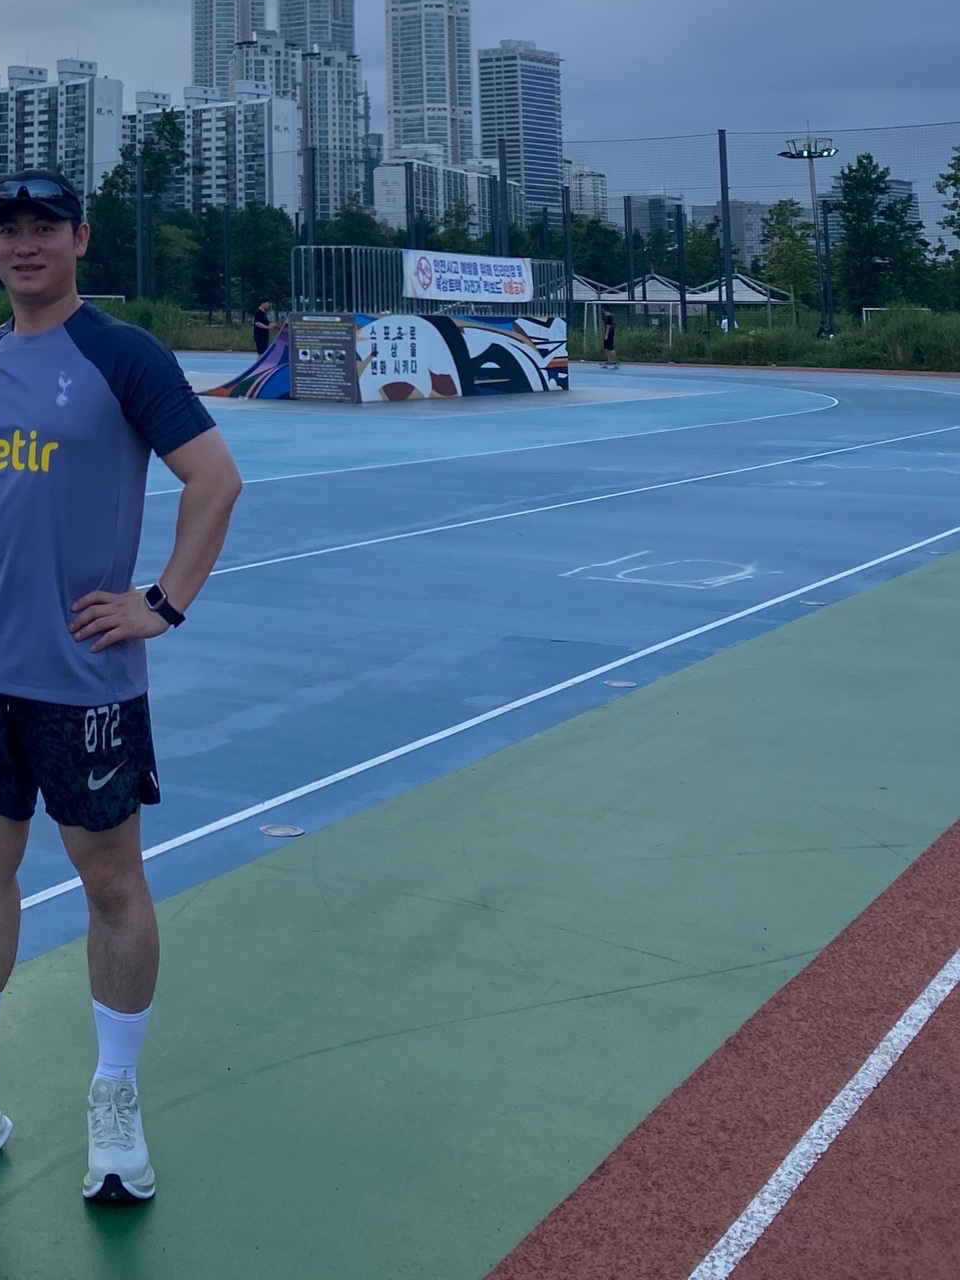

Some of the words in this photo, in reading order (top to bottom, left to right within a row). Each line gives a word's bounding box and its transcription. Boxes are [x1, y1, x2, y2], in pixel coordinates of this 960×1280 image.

[463, 280, 482, 294] 자전거
[483, 281, 503, 294] 킥보드
[371, 360, 387, 376] 변화
[393, 360, 417, 375] 시키다
[84, 703, 122, 753] 072
